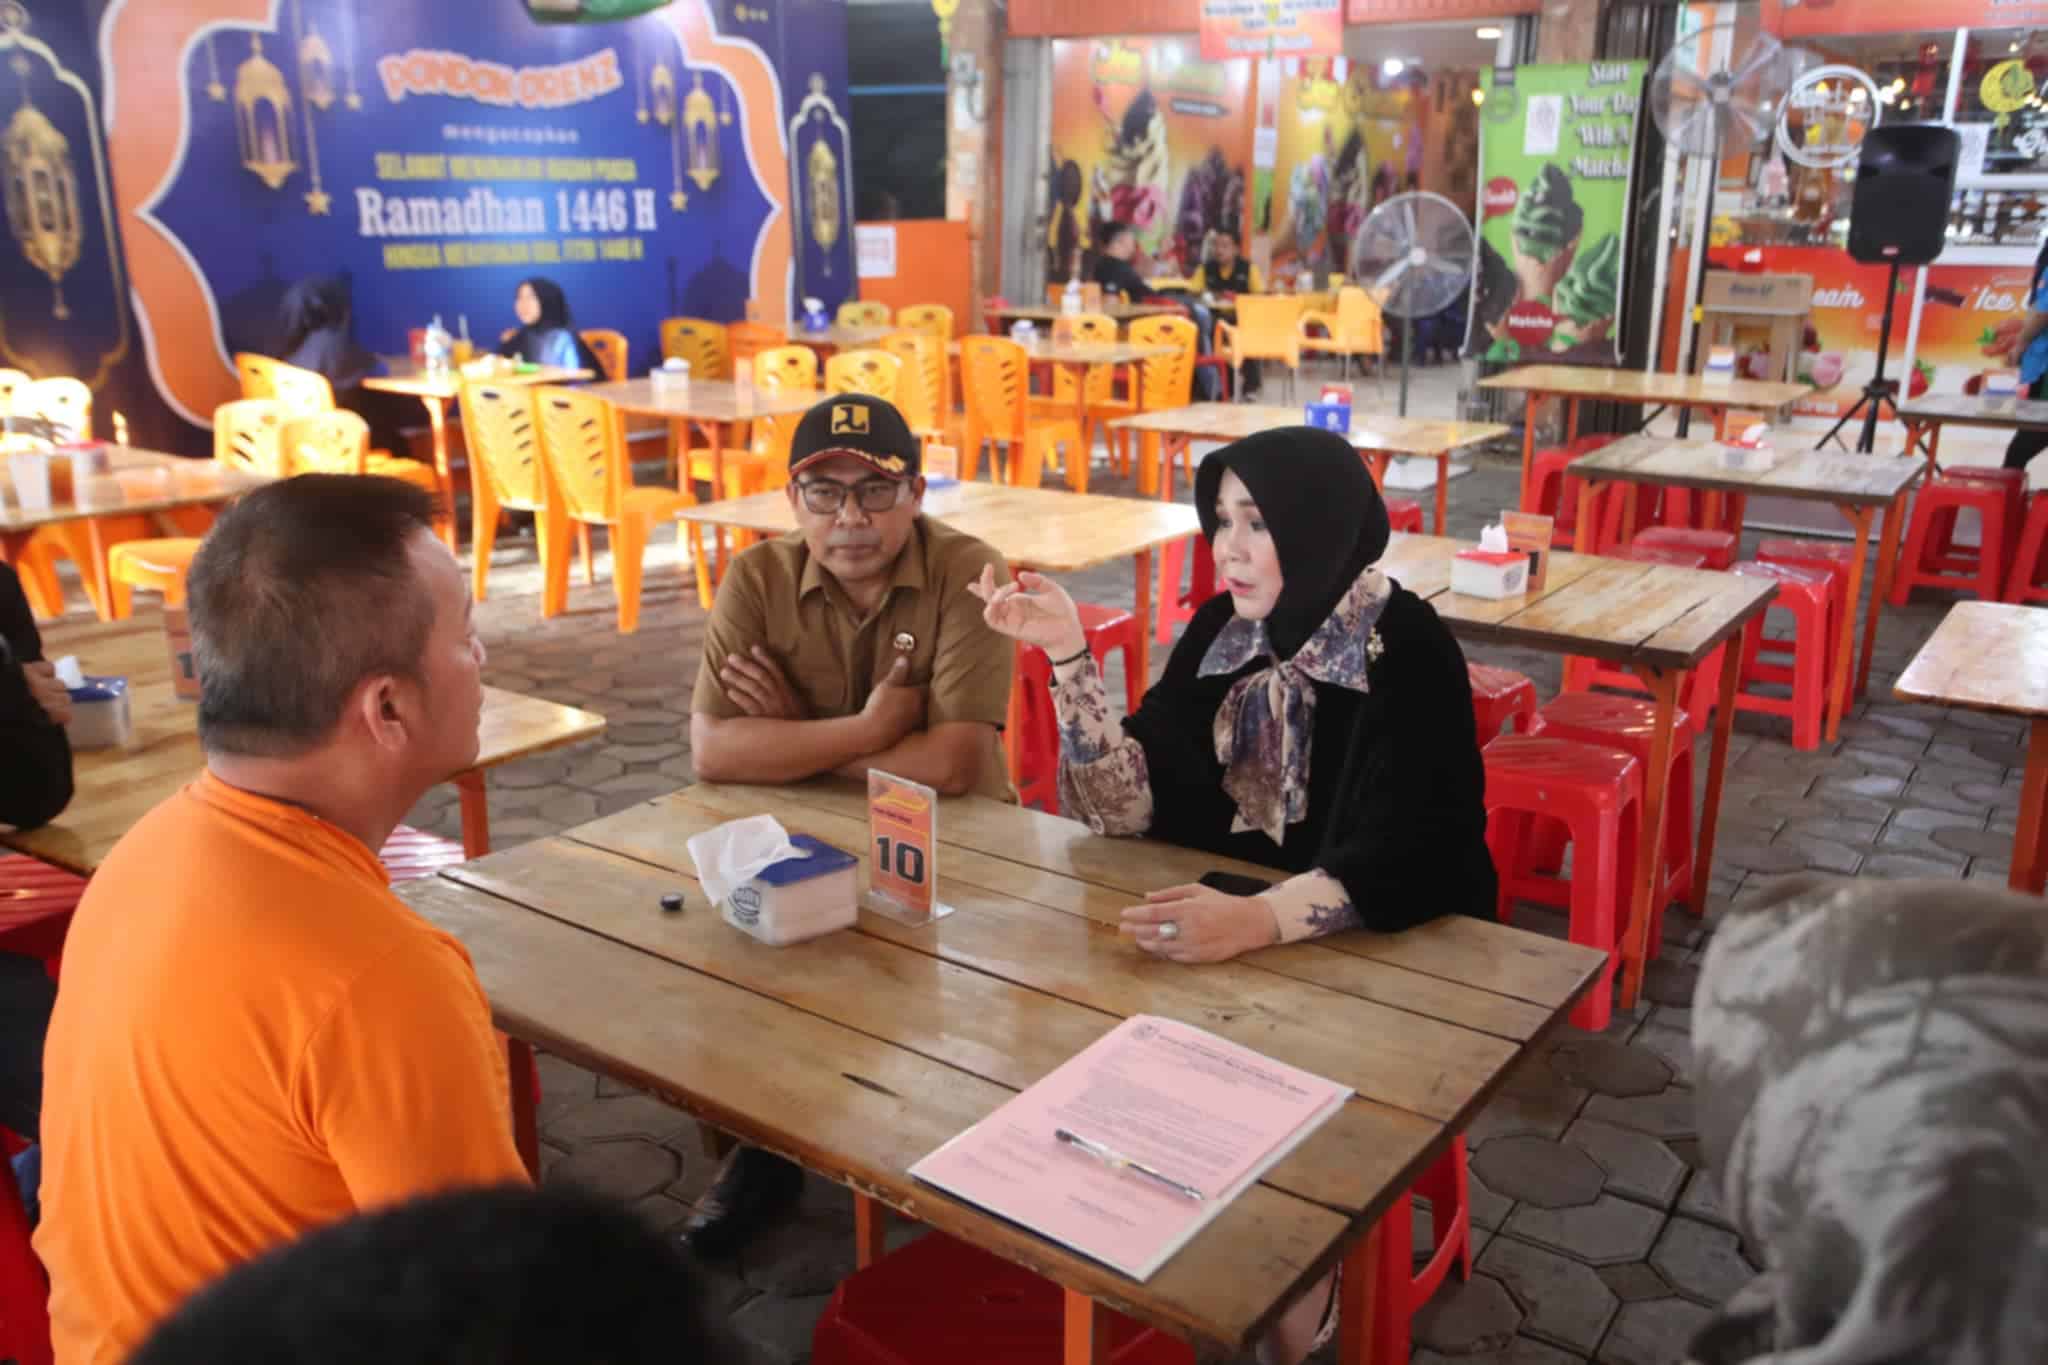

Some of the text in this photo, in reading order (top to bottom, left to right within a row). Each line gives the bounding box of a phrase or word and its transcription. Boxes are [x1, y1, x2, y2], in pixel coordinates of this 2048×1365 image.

[355, 185, 658, 237] Ramadhan 1446 H
[875, 836, 926, 885] 10
